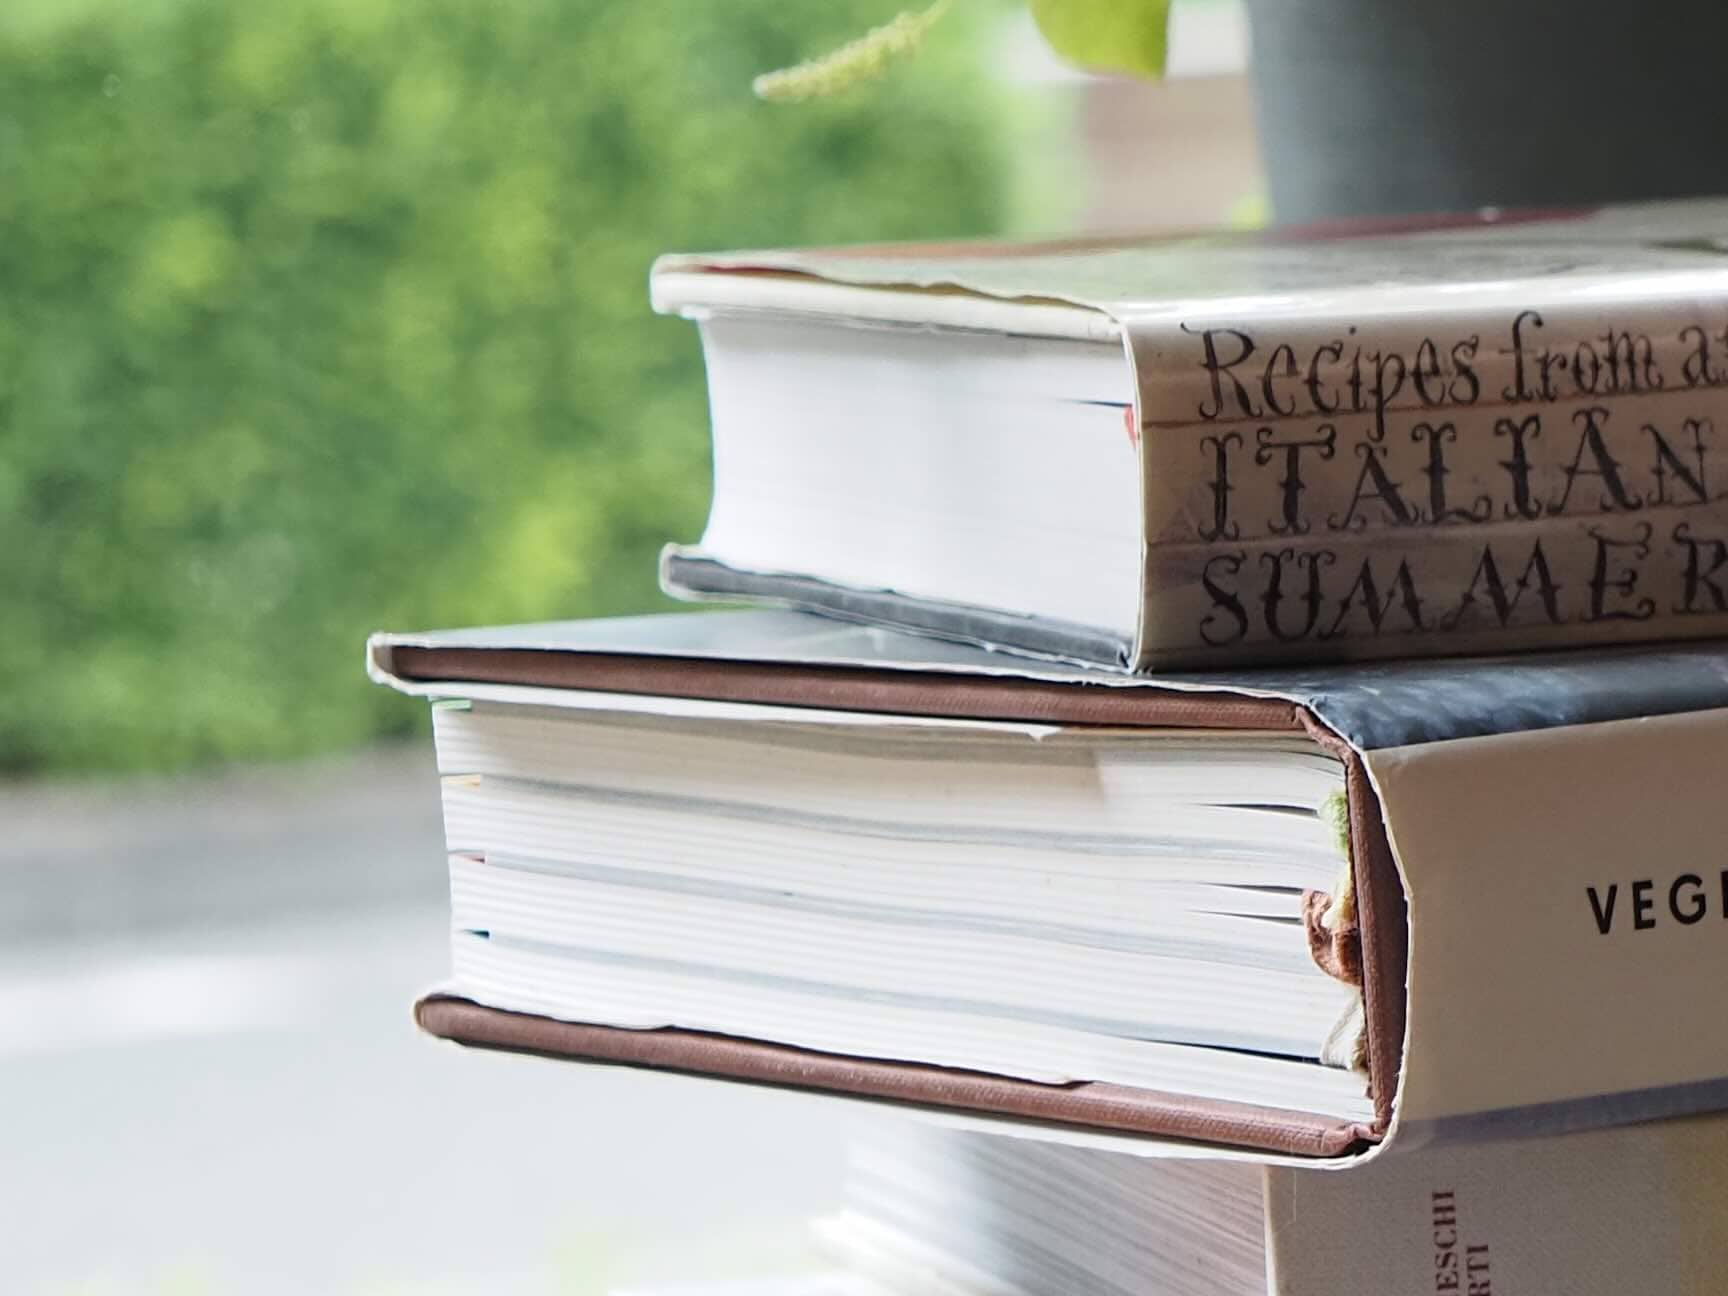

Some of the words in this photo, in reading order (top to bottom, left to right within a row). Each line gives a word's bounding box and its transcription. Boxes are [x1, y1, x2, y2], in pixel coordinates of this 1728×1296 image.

[1181, 315, 1481, 440] Recipes
[1500, 309, 1665, 403] from
[1197, 406, 1716, 542] ITALIAN
